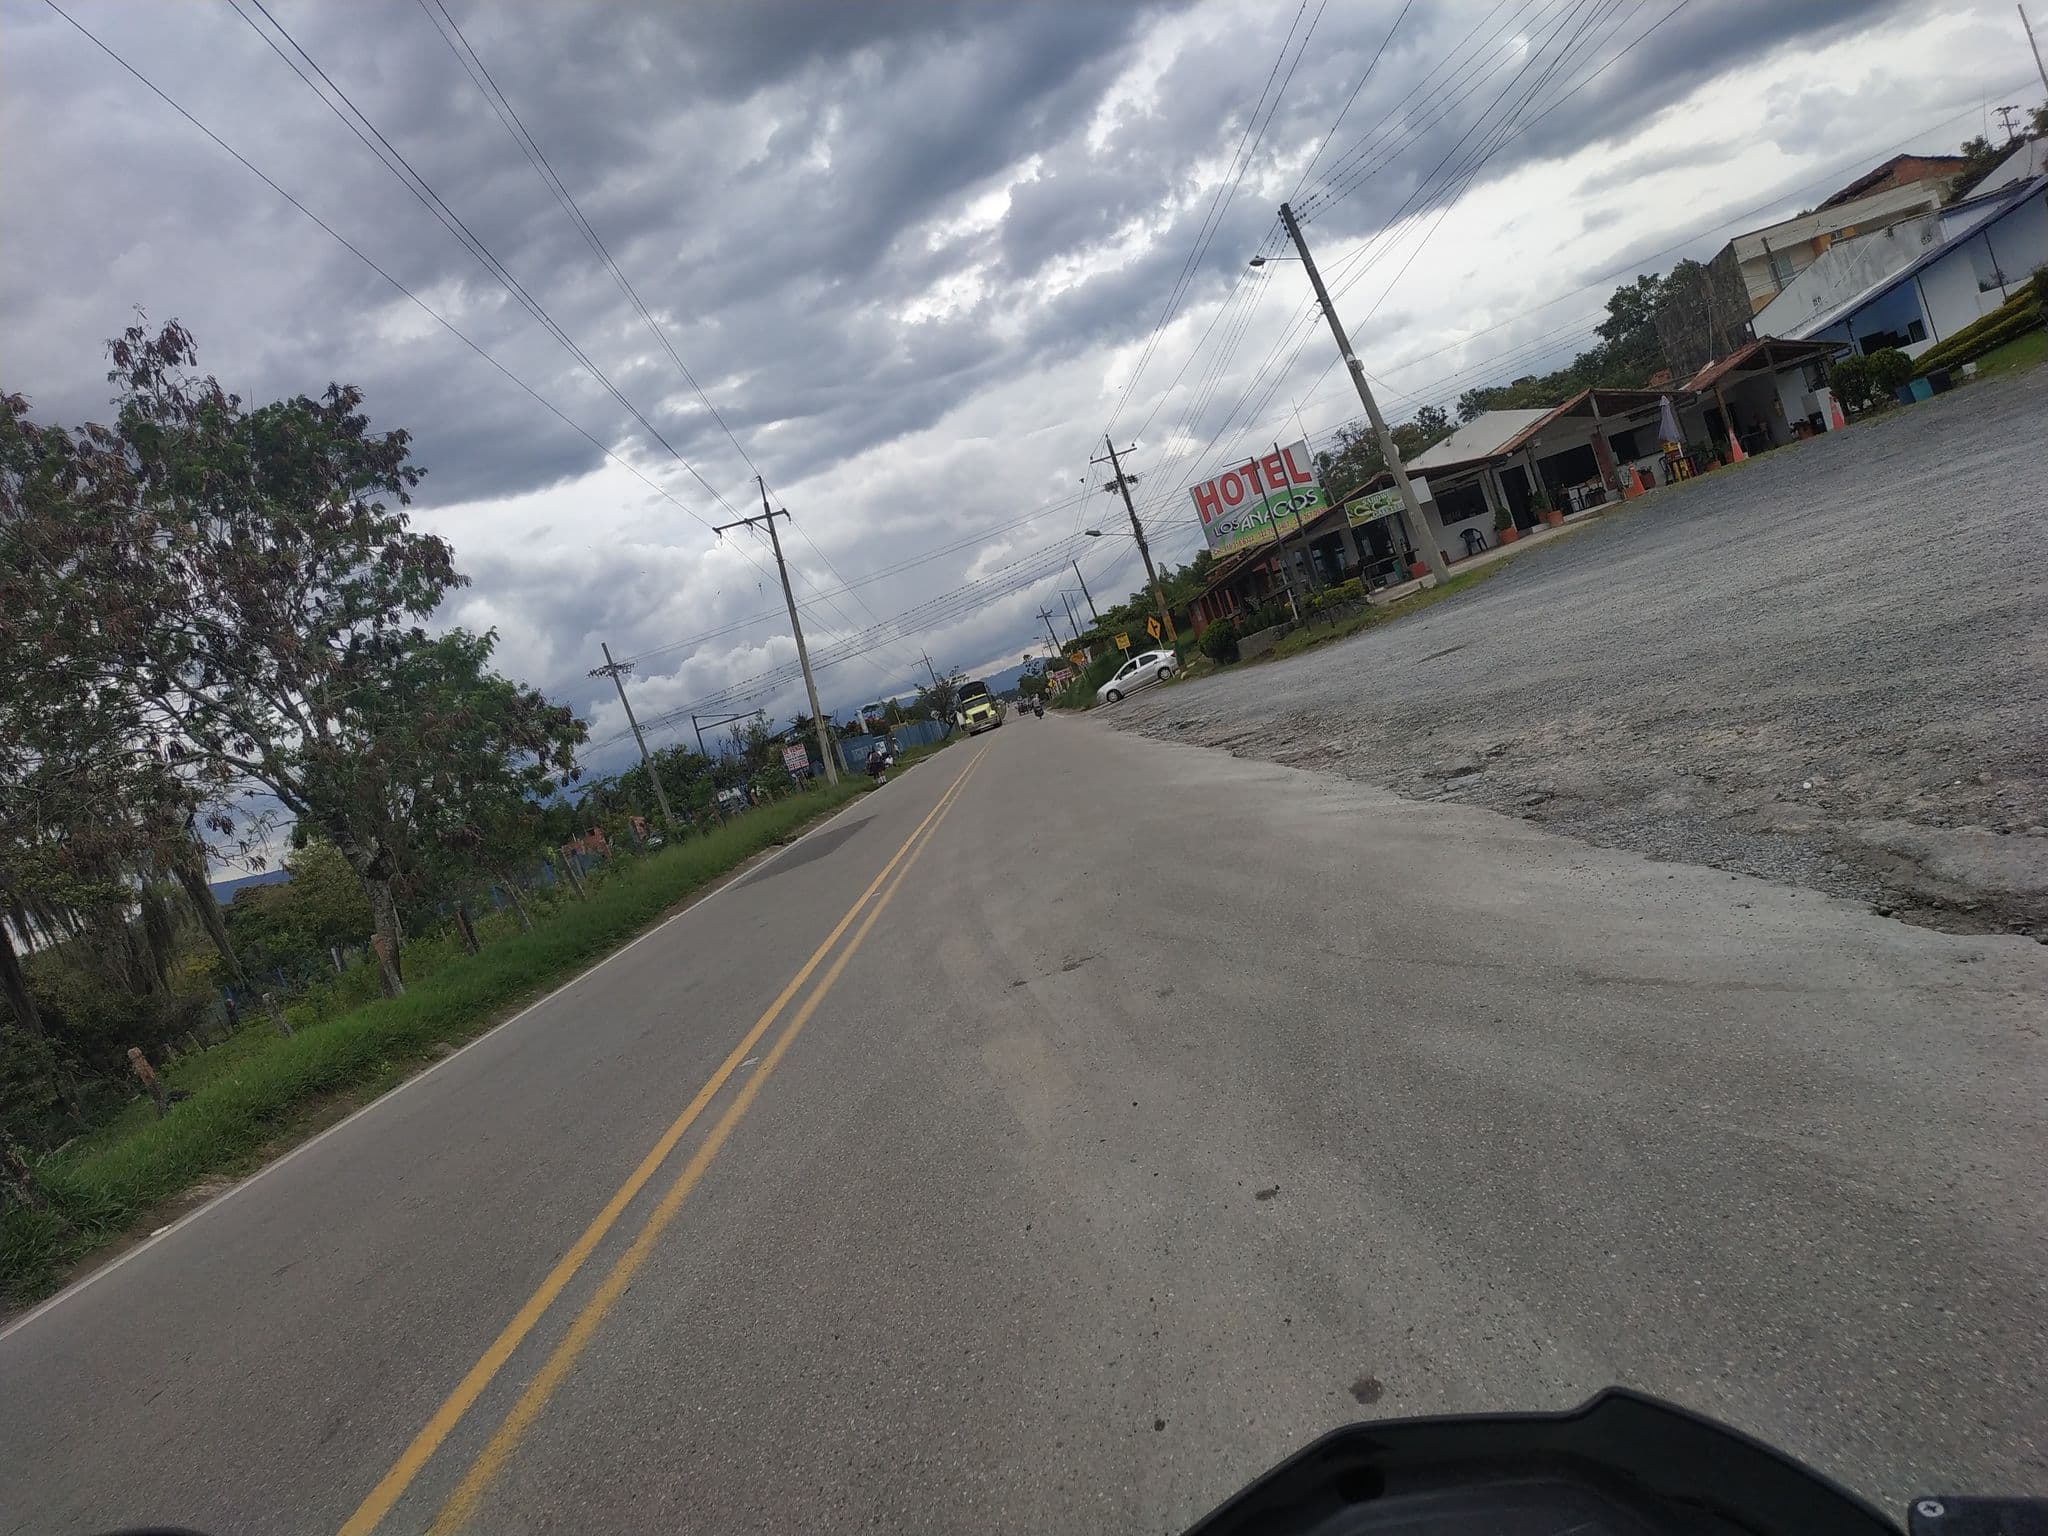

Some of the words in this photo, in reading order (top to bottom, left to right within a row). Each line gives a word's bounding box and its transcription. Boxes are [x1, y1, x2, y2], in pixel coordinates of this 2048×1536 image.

[1193, 448, 1313, 524] HOTEL
[1213, 519, 1240, 537] LOS
[1240, 489, 1319, 532] ANACOS
